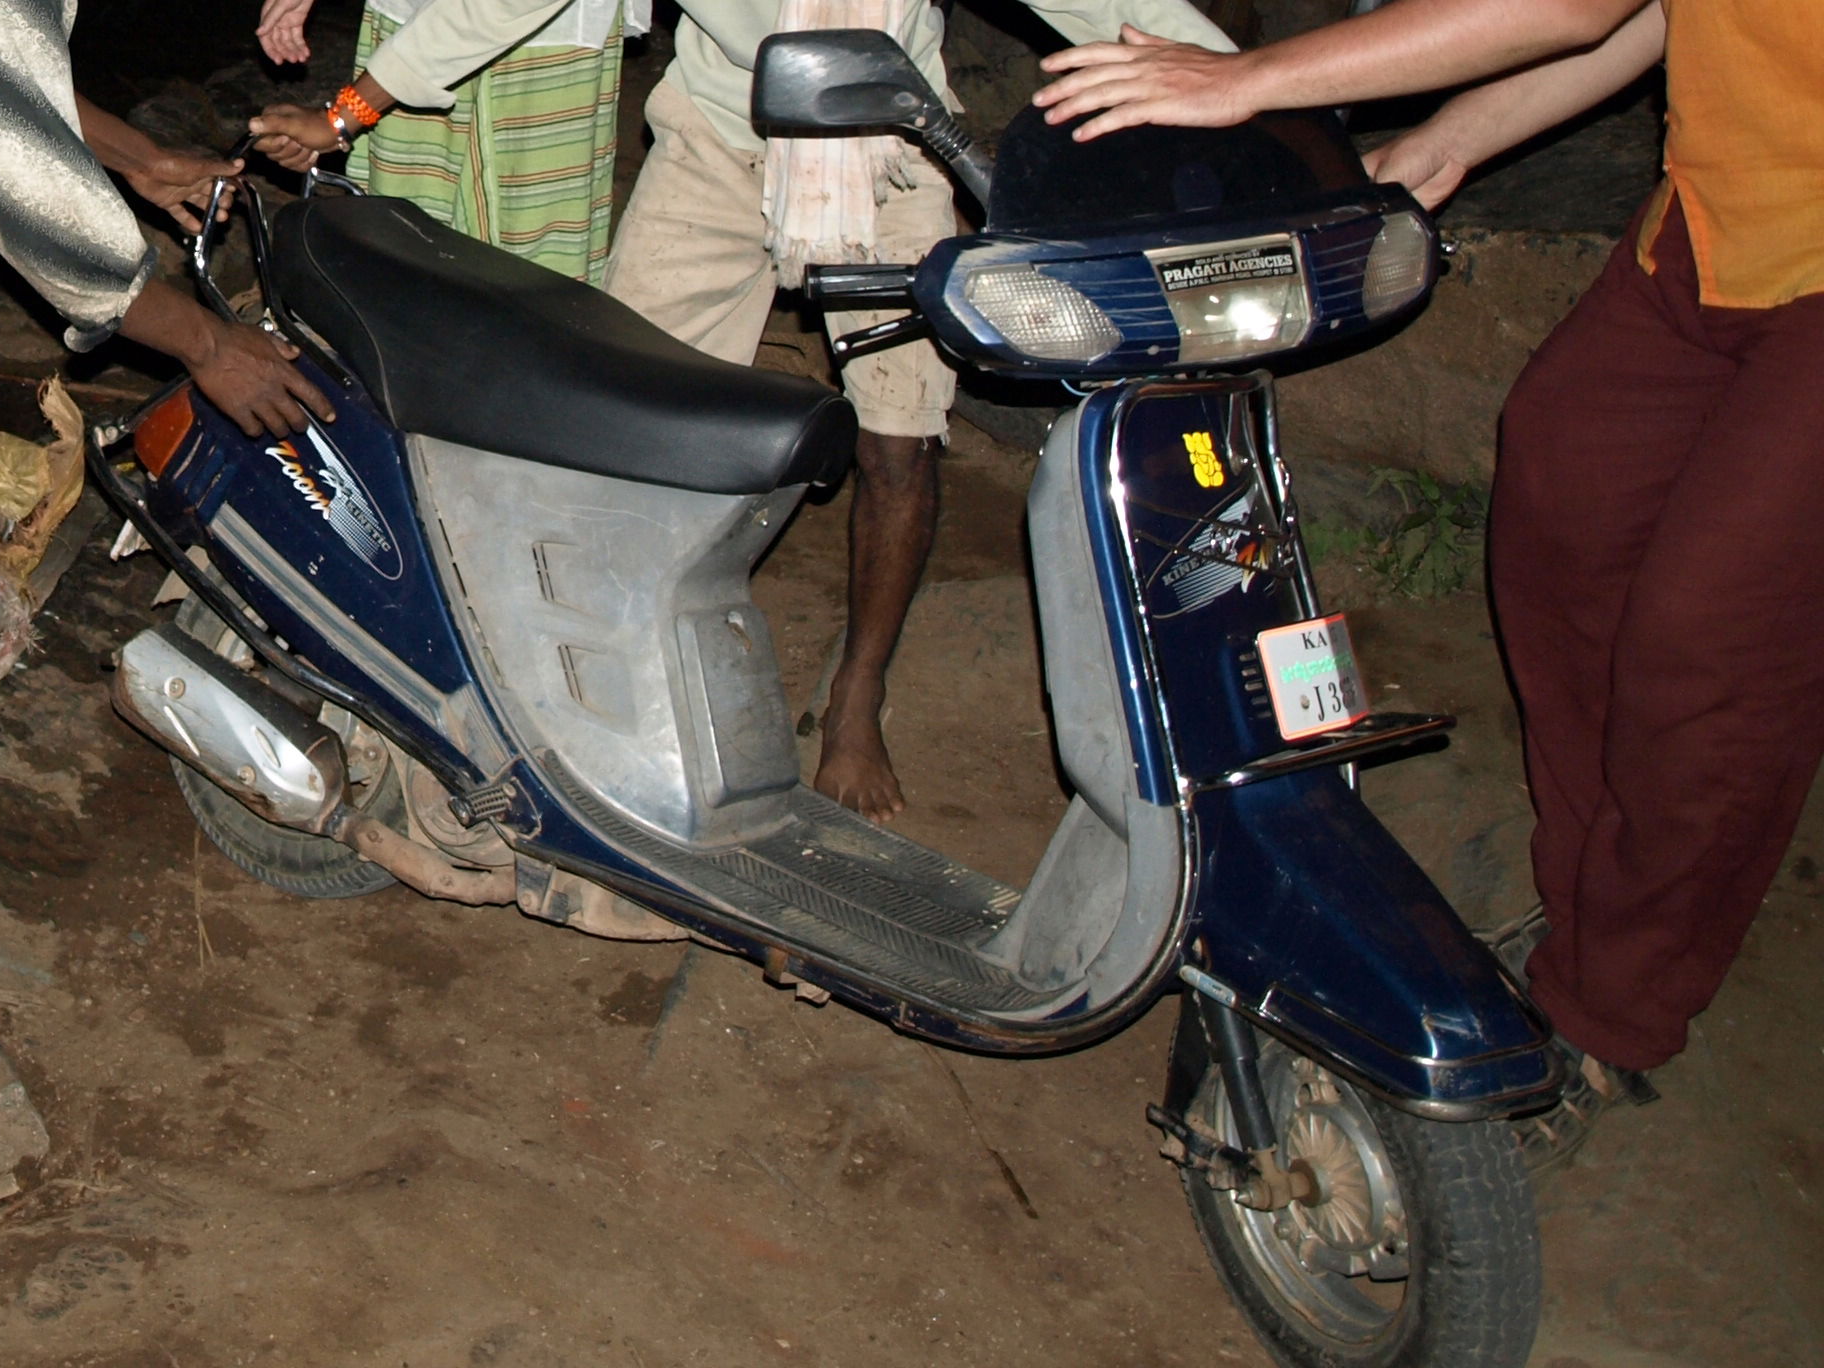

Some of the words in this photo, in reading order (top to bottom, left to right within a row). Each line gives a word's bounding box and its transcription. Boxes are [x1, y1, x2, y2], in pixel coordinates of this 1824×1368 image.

[1163, 262, 1228, 283] PRAGATI
[1229, 254, 1294, 273] AGENCIES
[345, 500, 392, 553] KINETIC
